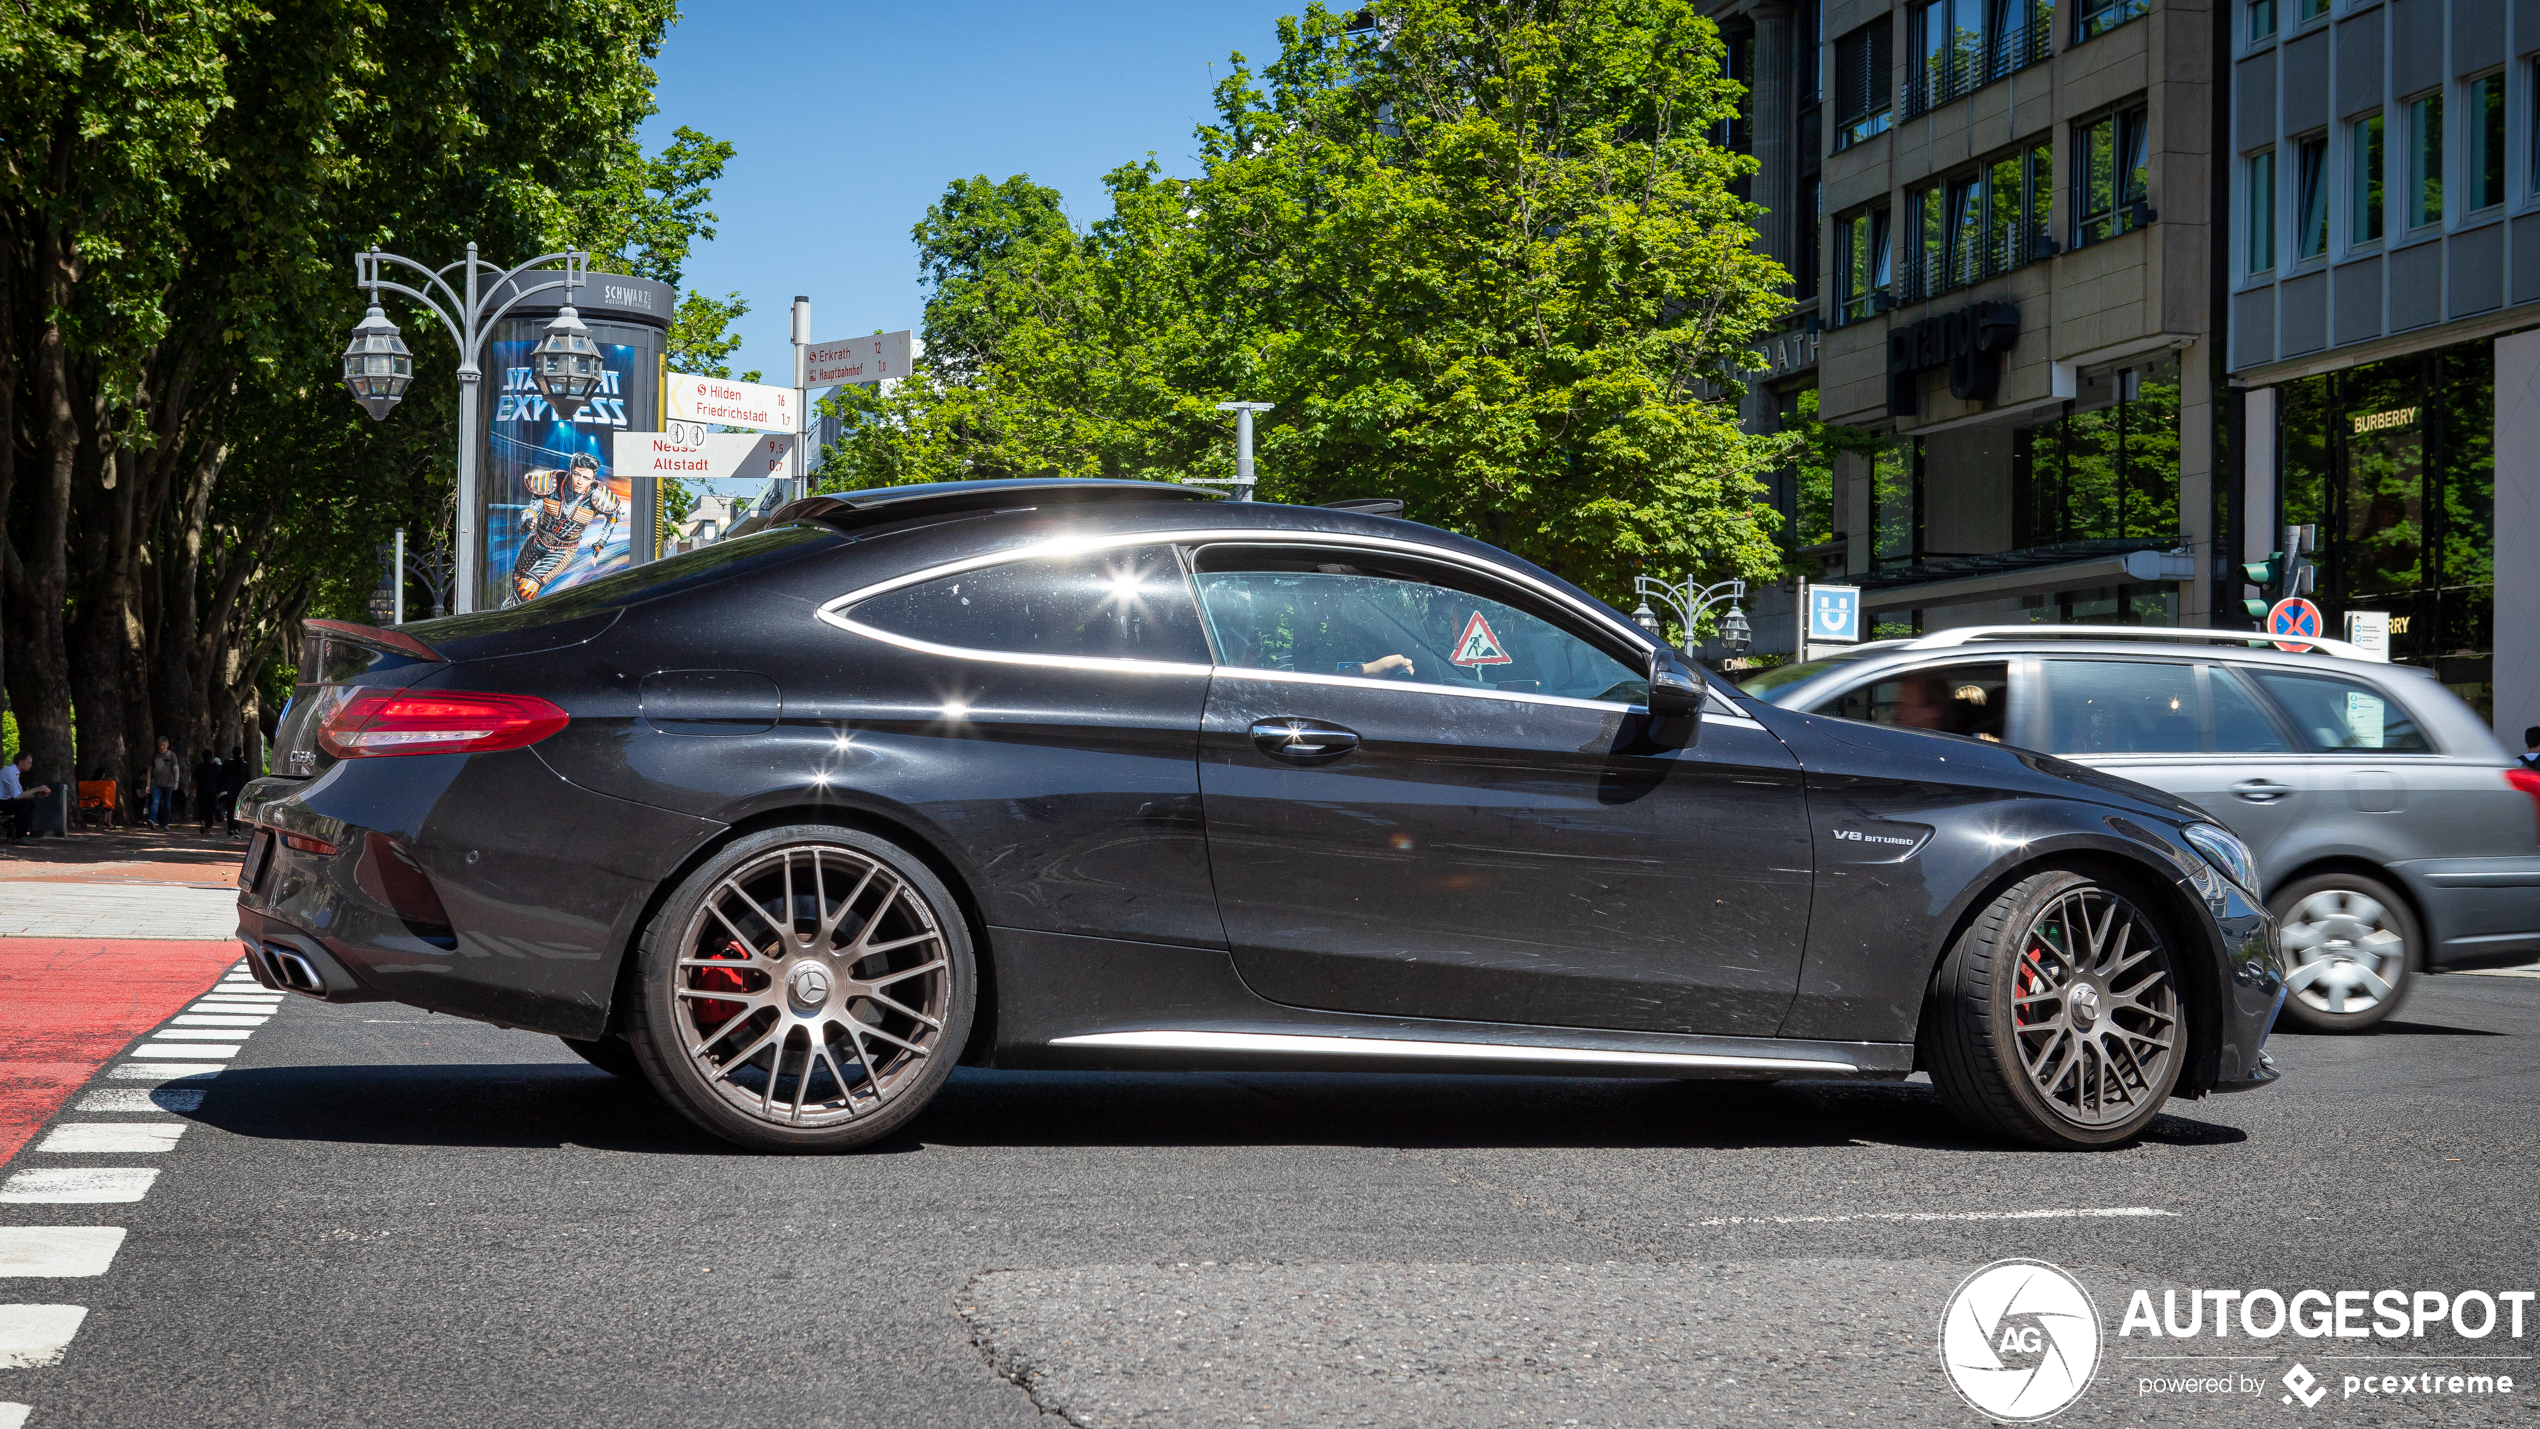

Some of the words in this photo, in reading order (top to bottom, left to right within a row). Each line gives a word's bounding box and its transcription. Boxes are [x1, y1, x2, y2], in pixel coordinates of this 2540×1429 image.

[605, 285, 648, 307] SCHWARZ
[819, 347, 851, 363] Erkrath
[875, 341, 882, 355] 12
[819, 363, 863, 382] Hauptbahnhof
[710, 385, 742, 401] Hilden
[778, 395, 785, 407] 16
[696, 402, 768, 423] Friedrichstadt
[2354, 406, 2417, 433] BURBERRY
[653, 458, 708, 471] Altstadt
[1833, 829, 1863, 842] V8
[1864, 835, 1914, 846] BITURBO
